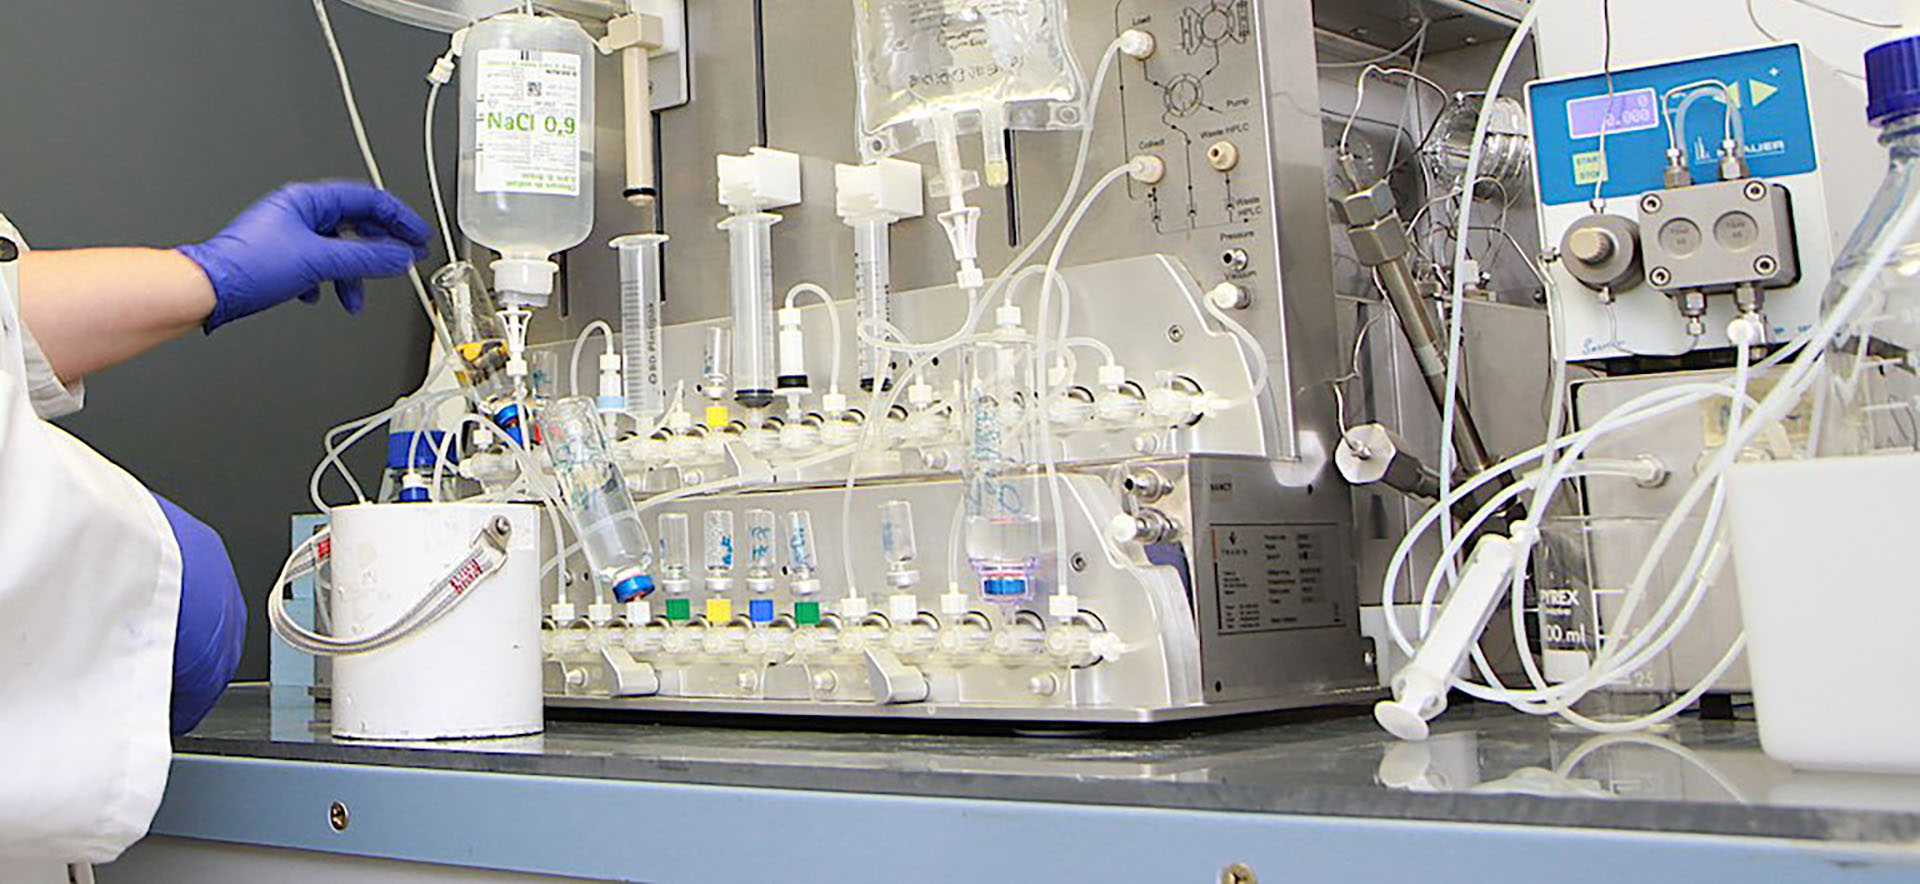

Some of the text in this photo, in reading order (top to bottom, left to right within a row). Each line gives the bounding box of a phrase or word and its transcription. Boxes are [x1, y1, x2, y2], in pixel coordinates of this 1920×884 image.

[1227, 97, 1249, 109] Pump
[487, 111, 576, 136] NaCl 0,9
